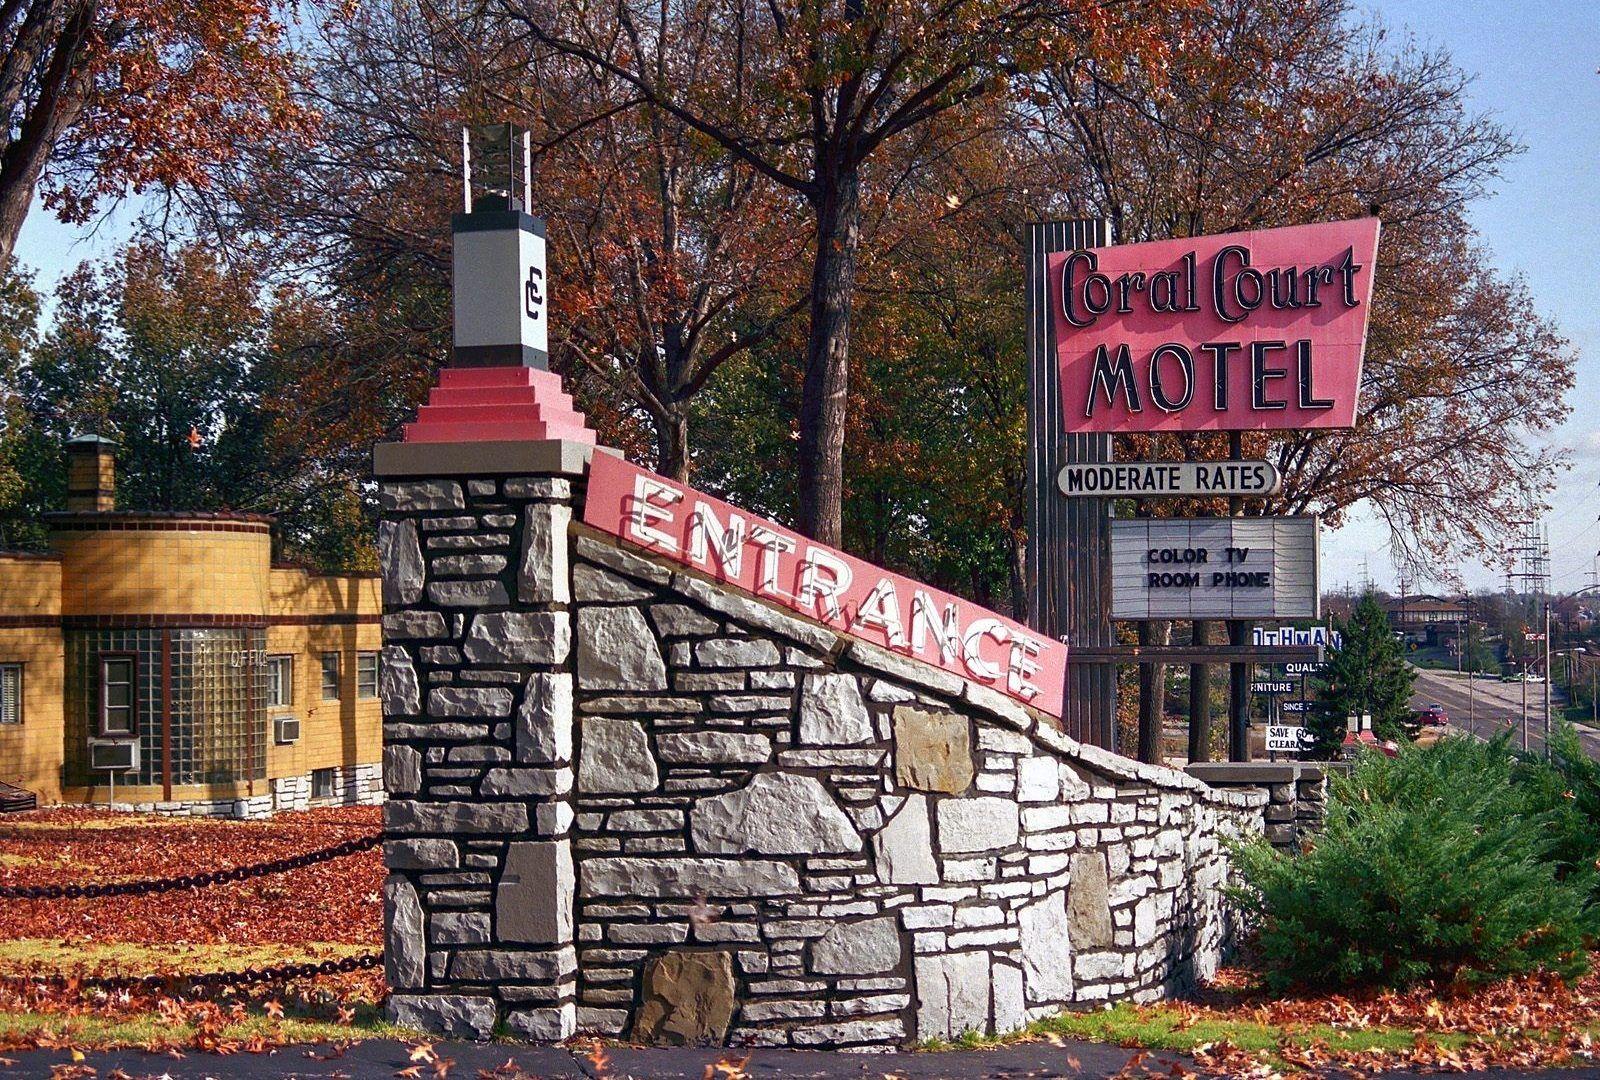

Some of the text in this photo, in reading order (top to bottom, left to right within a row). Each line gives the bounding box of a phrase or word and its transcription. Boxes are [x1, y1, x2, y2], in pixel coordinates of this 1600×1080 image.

[1061, 245, 1362, 328] Coral Court
[1086, 339, 1335, 418] MOTEL
[1068, 465, 1265, 492] MODERATE RATES
[1149, 547, 1249, 563] COLOR TV
[630, 474, 1050, 700] ENTRANCE
[1149, 571, 1270, 587] ROOM PHONE
[1283, 702, 1303, 711] SINCE
[1269, 727, 1289, 738] SAVE
